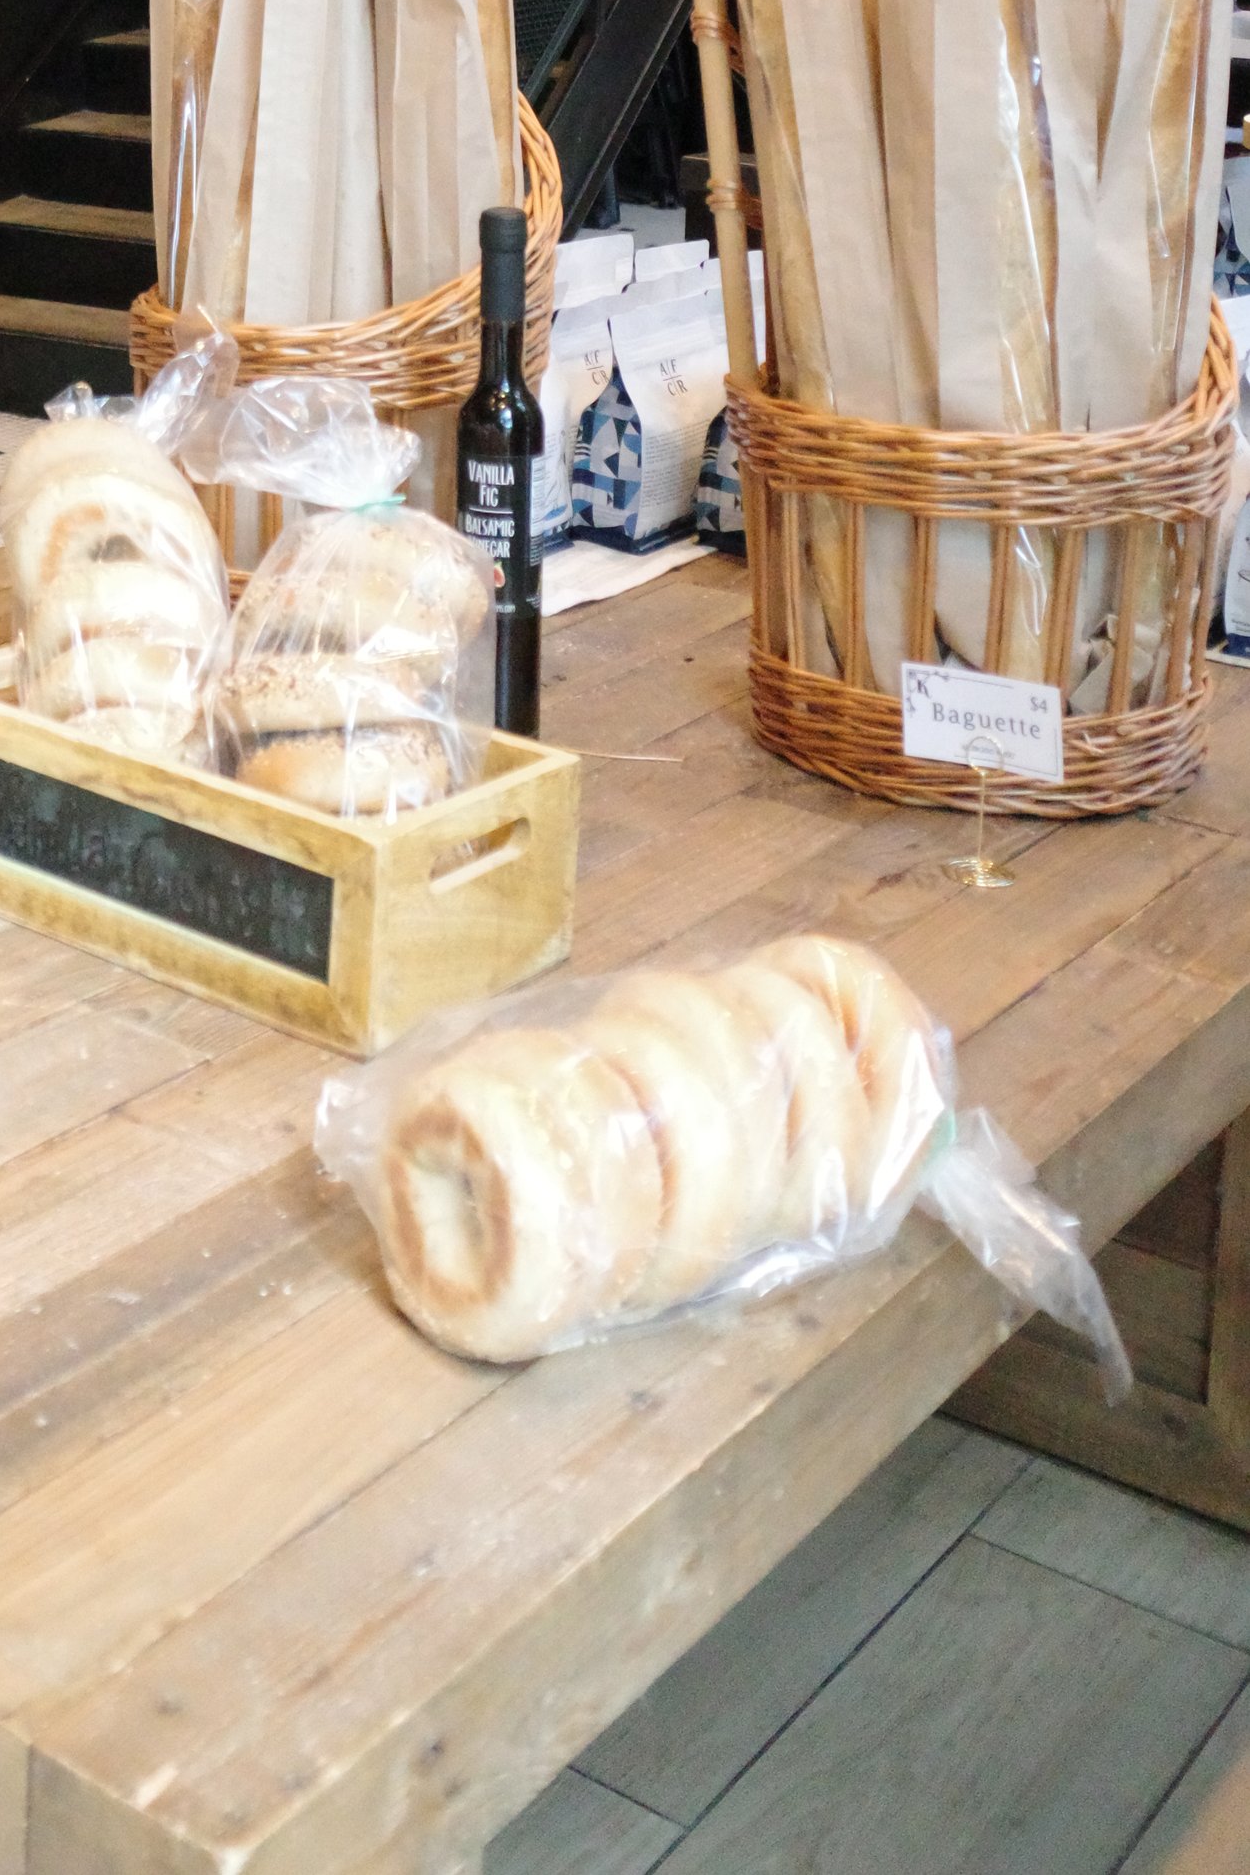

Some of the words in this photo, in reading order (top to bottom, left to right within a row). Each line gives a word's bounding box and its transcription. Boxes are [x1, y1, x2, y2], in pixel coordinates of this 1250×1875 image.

[467, 458, 515, 485] VANILLA
[479, 485, 499, 508] FIG
[464, 513, 515, 538] BALSAMIC
[1030, 696, 1048, 713] $4
[932, 702, 1042, 740] Baguette
